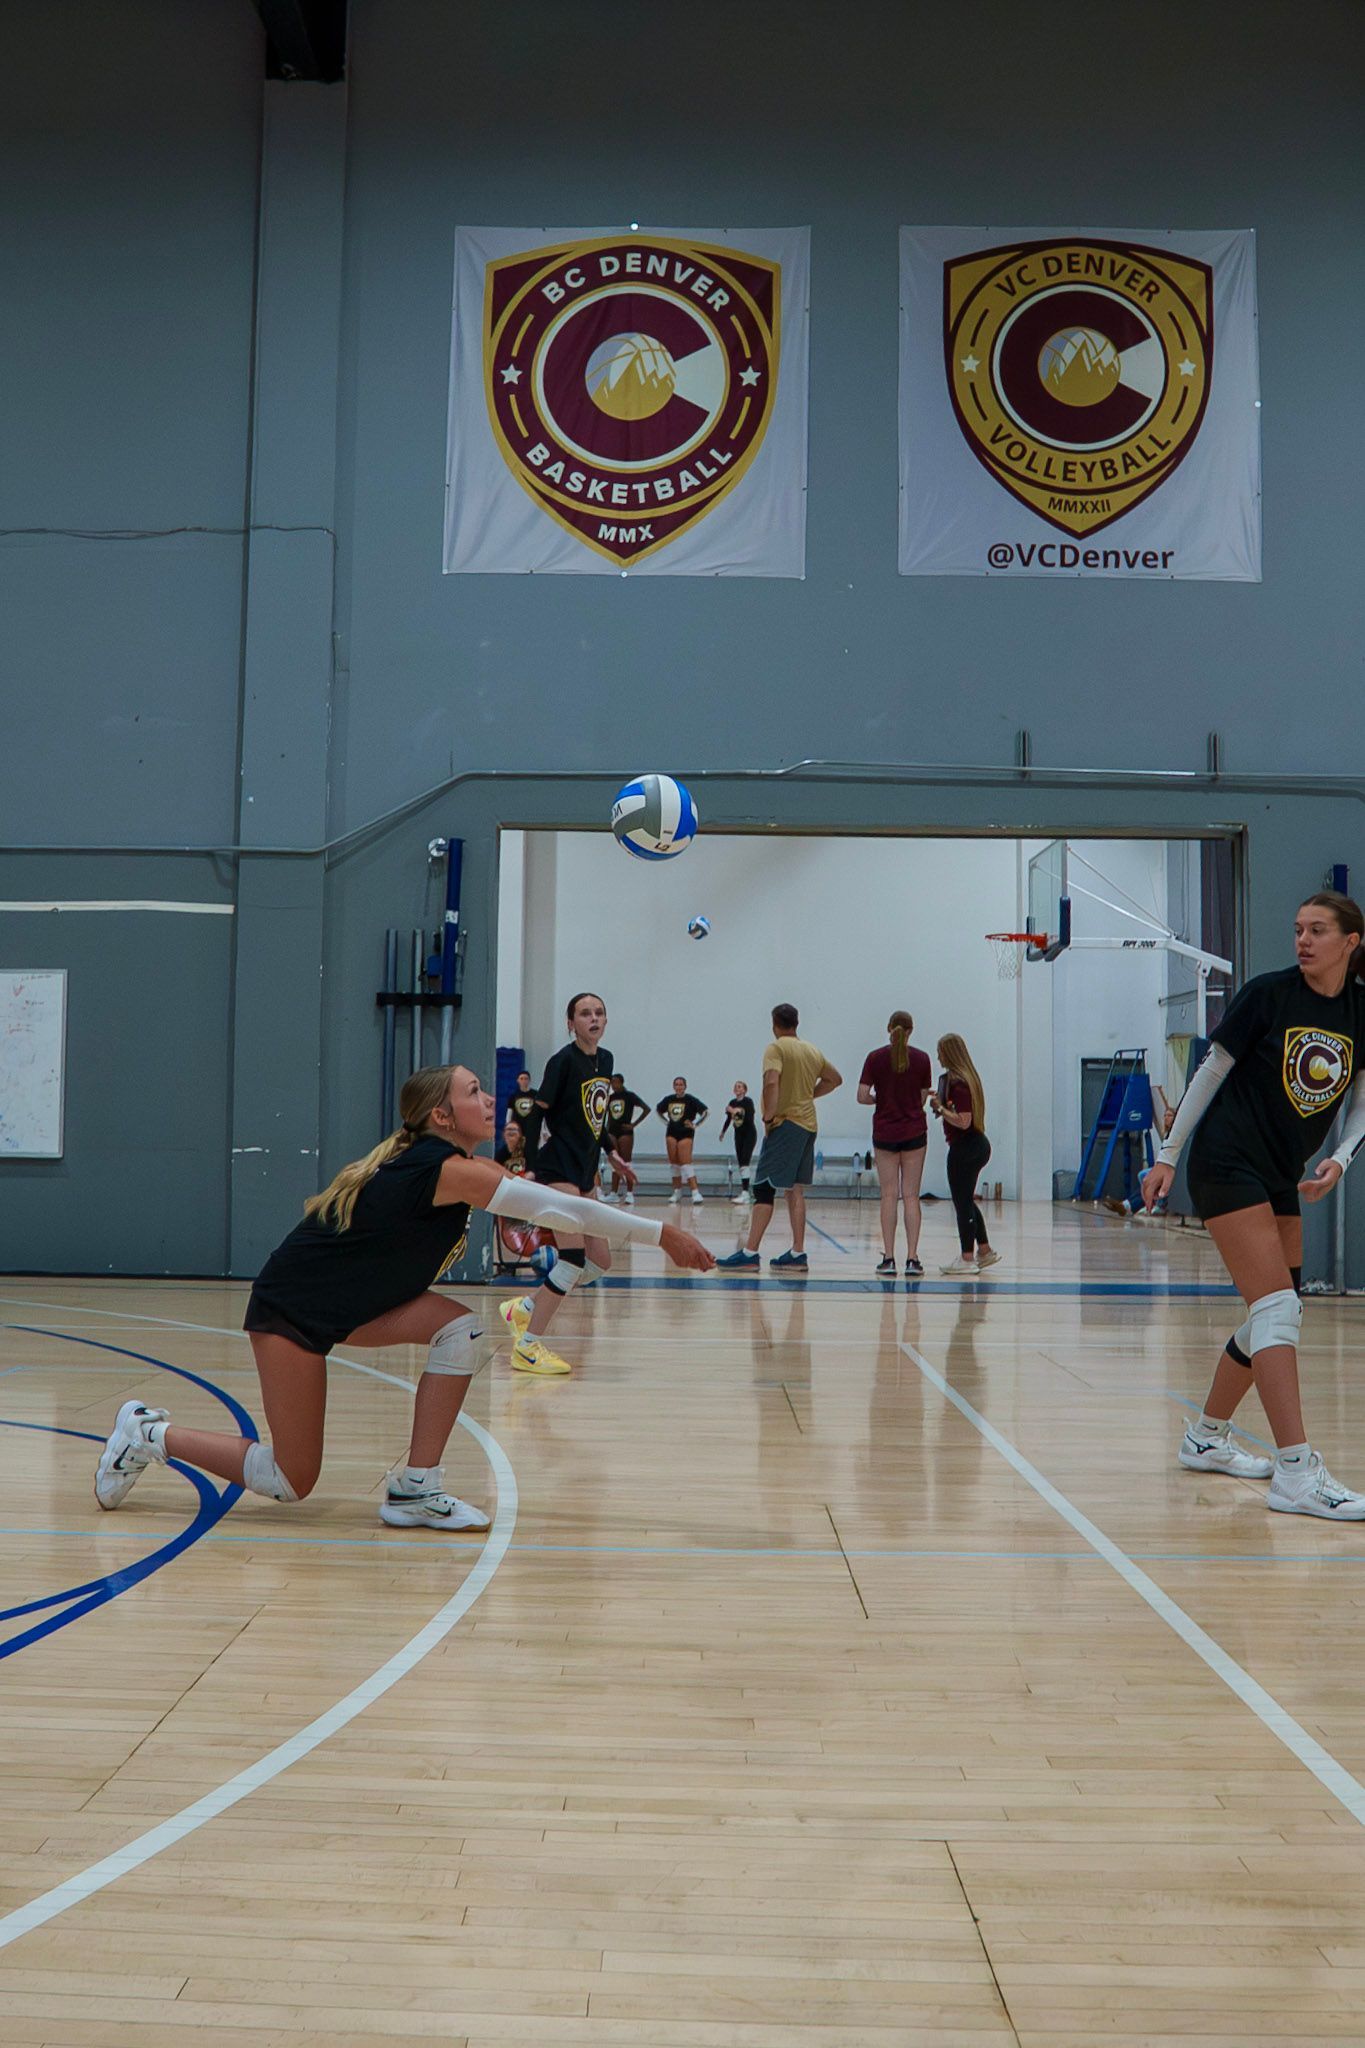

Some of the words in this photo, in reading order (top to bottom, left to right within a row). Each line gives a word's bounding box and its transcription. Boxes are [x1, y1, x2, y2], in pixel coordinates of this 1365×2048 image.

[541, 268, 586, 303] BC
[599, 252, 731, 313] DENVER
[995, 265, 1037, 297] VC
[1042, 253, 1161, 304] DENVER
[988, 423, 1172, 483] VOLLEYBALL
[526, 442, 733, 505] BASKETBALL
[1048, 496, 1111, 514] MMXXII
[597, 523, 655, 543] MMX
[987, 543, 1175, 569] @VCDenver
[1290, 1080, 1335, 1102] VOLLEYBALL
